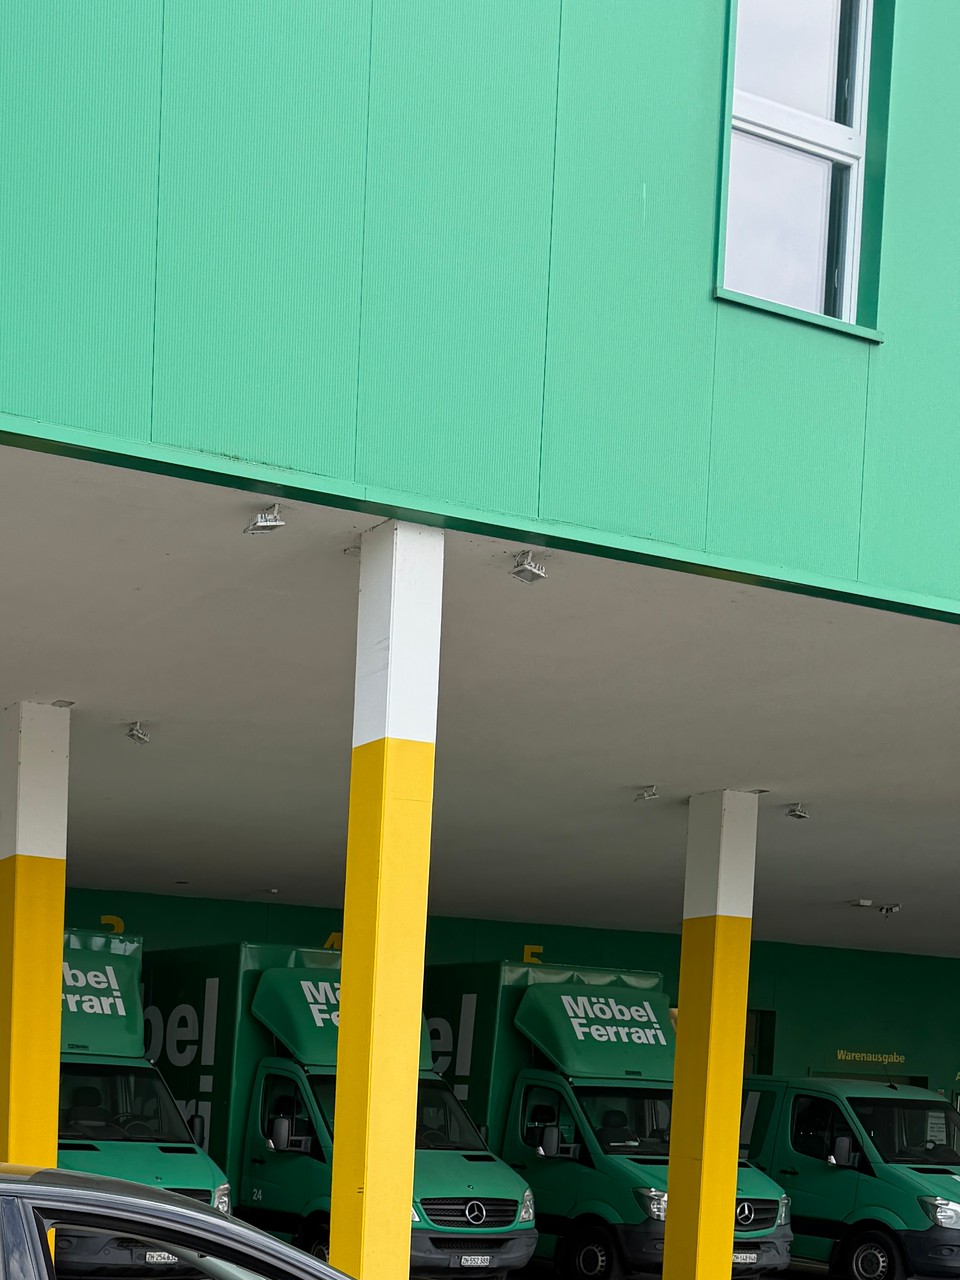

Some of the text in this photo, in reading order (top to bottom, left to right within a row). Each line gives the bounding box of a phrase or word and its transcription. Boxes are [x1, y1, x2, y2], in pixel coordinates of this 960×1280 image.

[62, 961, 119, 990] bel
[561, 995, 658, 1023] Möbel
[570, 1018, 668, 1046] Ferrari
[837, 1050, 906, 1065] Warenausgabe
[252, 1188, 263, 1201] 24
